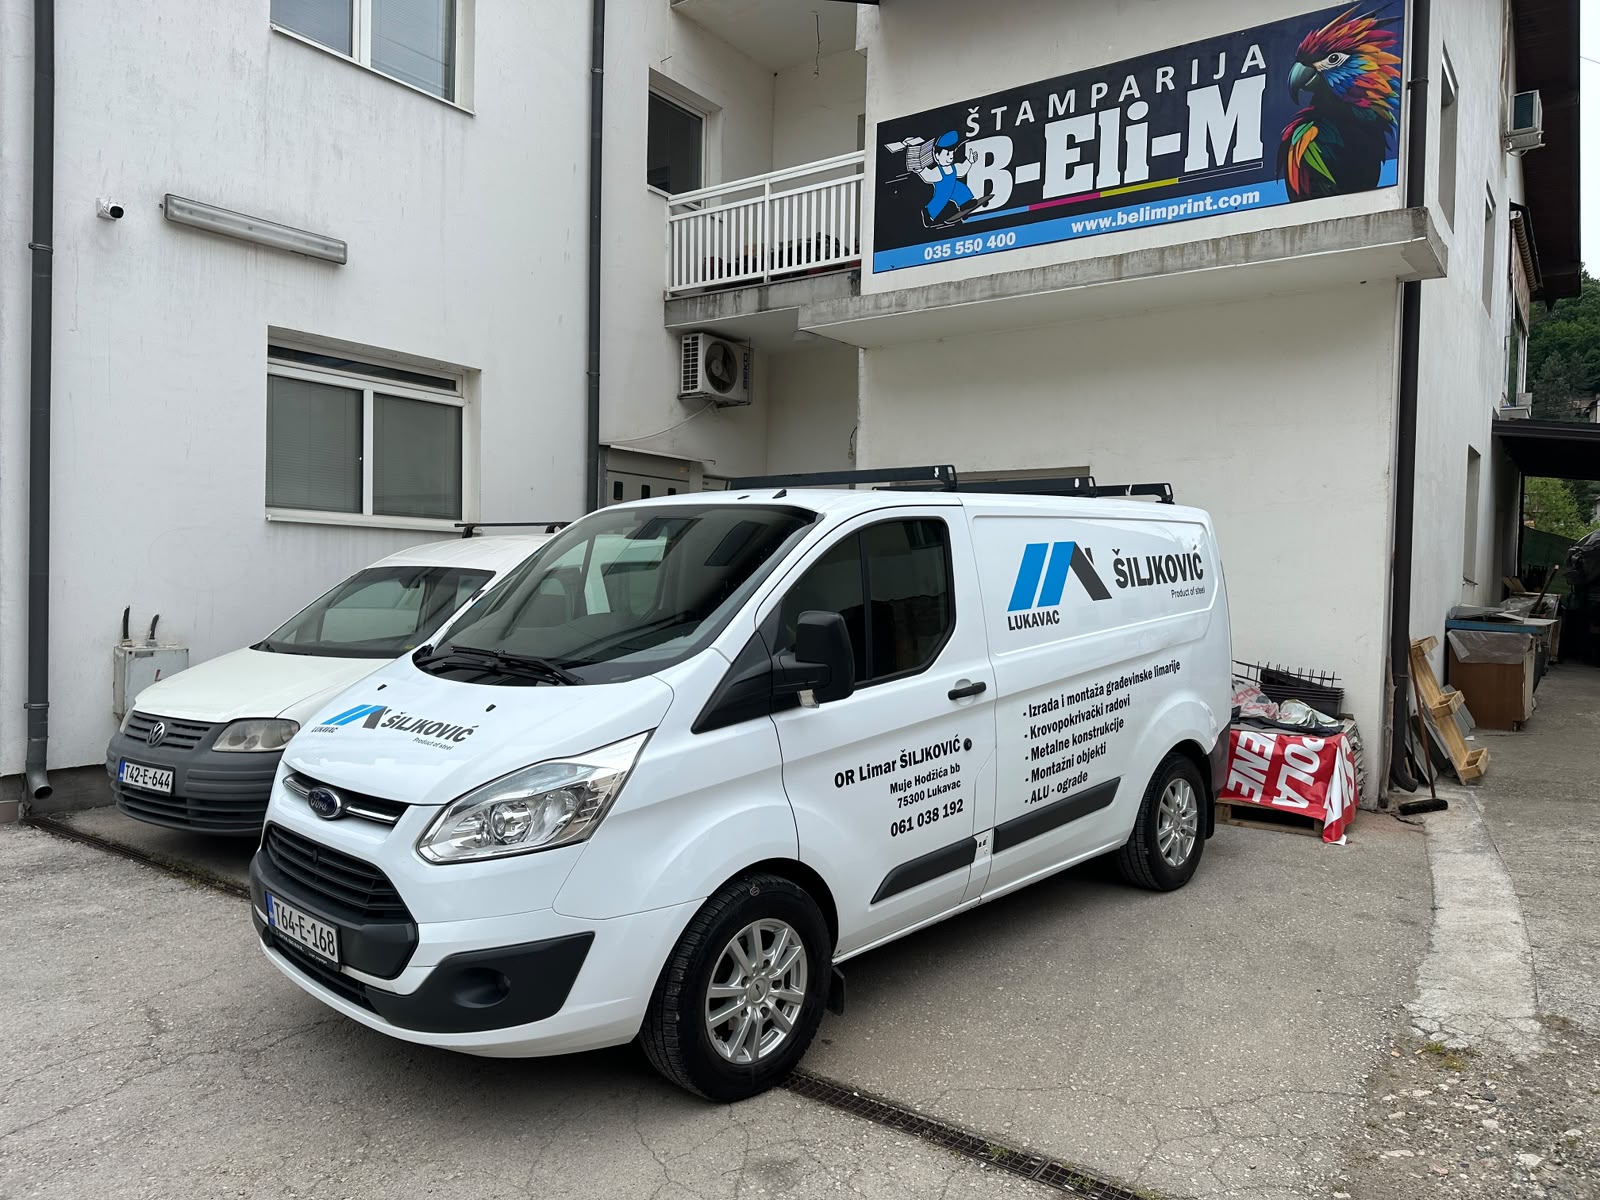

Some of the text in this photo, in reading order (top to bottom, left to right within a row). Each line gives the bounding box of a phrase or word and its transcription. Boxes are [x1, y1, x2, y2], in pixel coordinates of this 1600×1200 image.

[966, 44, 1266, 137] ŠTAMPARIJA
[965, 74, 1265, 212] B-Eli-M
[1072, 191, 1259, 232] www.belimprint.com
[924, 232, 1016, 260] 035 550 400
[1112, 545, 1203, 588] ŠILJKOVIĆ
[1171, 589, 1190, 598] Product
[1195, 586, 1205, 594] steel
[1008, 610, 1060, 630] LUKAVAC
[1029, 698, 1059, 718] Izrada
[1061, 694, 1064, 707] i
[1067, 683, 1104, 706] montaža
[1106, 669, 1152, 696] građevinske
[1154, 660, 1180, 677] limarije
[381, 712, 478, 742] ŠILJKOVIĆ
[1030, 703, 1103, 739] Krovopokrivački
[1106, 694, 1130, 714] radovi
[413, 737, 434, 746] Product
[1031, 739, 1069, 761] Metalne
[1072, 717, 1124, 746] konstrukcije
[126, 765, 170, 789] T42-E-644
[835, 734, 960, 788] OR Limar ŠILJKOVIĆ
[890, 763, 960, 794] Muje Hodžića bb
[1032, 754, 1074, 782] Montažni
[1077, 742, 1106, 764] objekti
[898, 780, 960, 808] 75300 Lukavac
[1030, 785, 1049, 804] ALU
[1057, 771, 1088, 793] ograde
[891, 799, 963, 836] 061 038 192
[274, 902, 335, 956] T64-E-168
